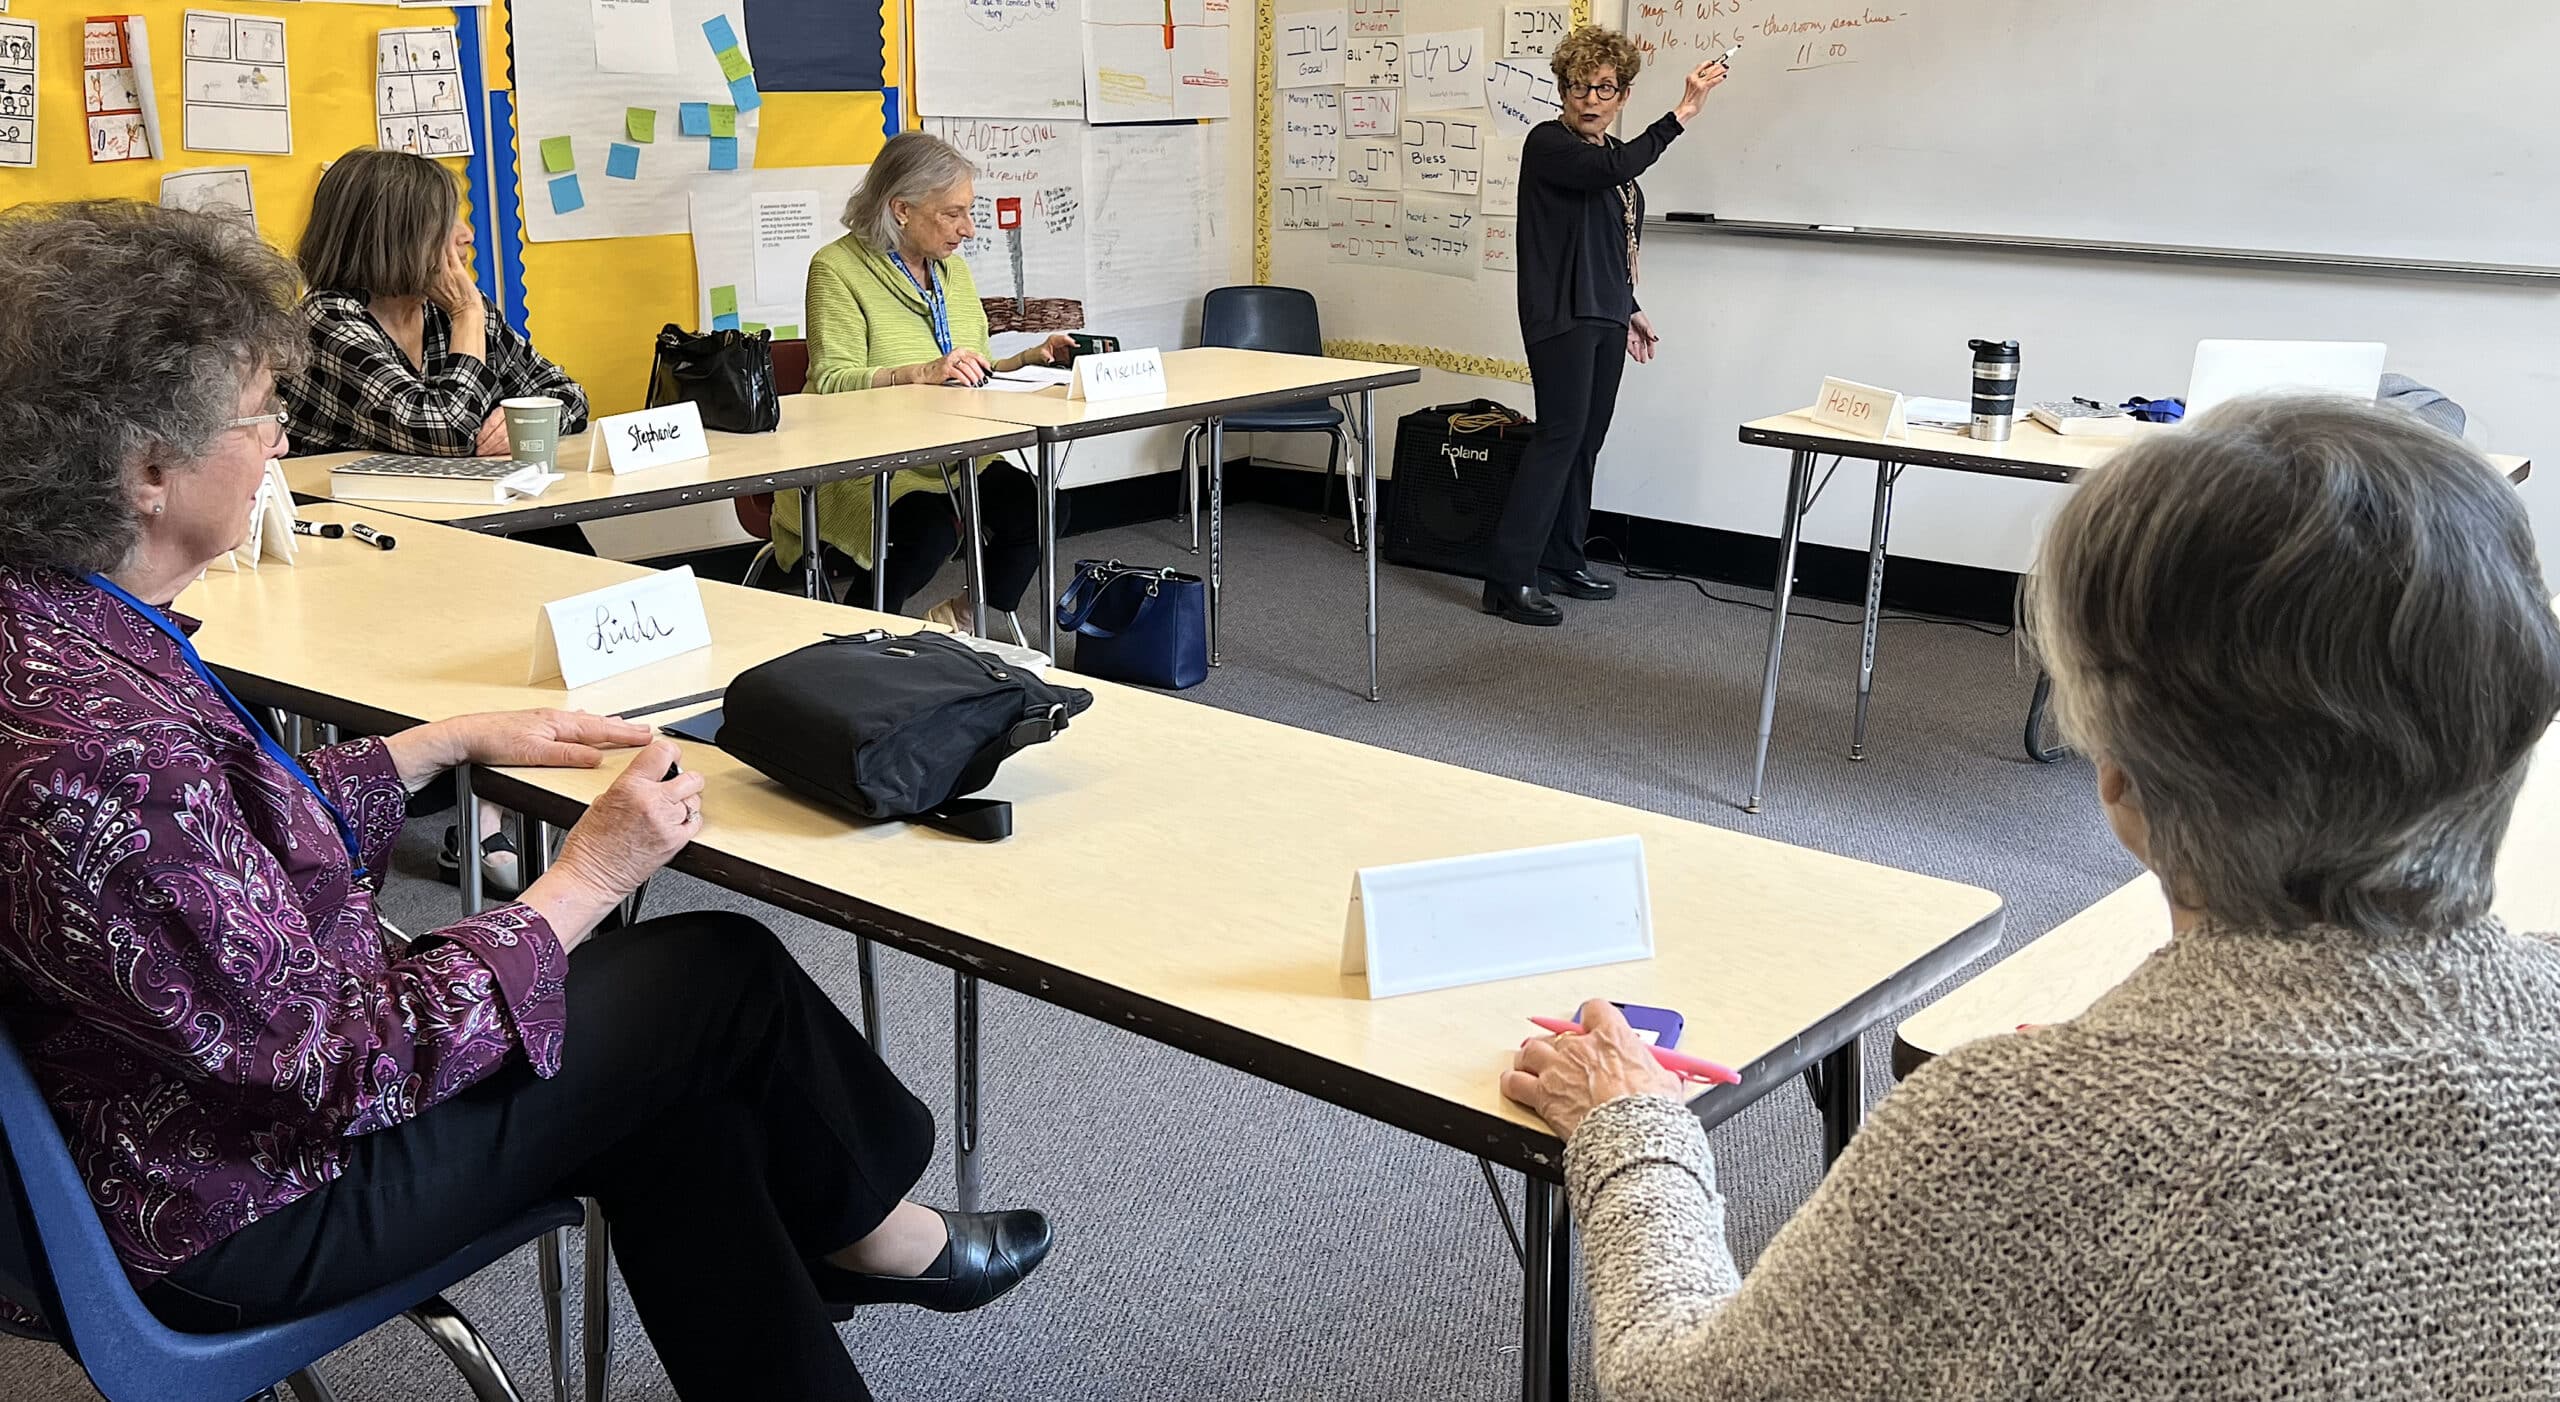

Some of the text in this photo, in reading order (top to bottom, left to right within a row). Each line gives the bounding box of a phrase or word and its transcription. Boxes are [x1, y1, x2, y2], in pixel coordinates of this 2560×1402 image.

[1411, 151, 1447, 165] Bless
[1349, 169, 1369, 187] Day
[1095, 360, 1157, 385] PRISCILLA
[627, 422, 681, 453] Stephanie
[1440, 443, 1489, 462] Roland
[586, 600, 675, 655] Linda
